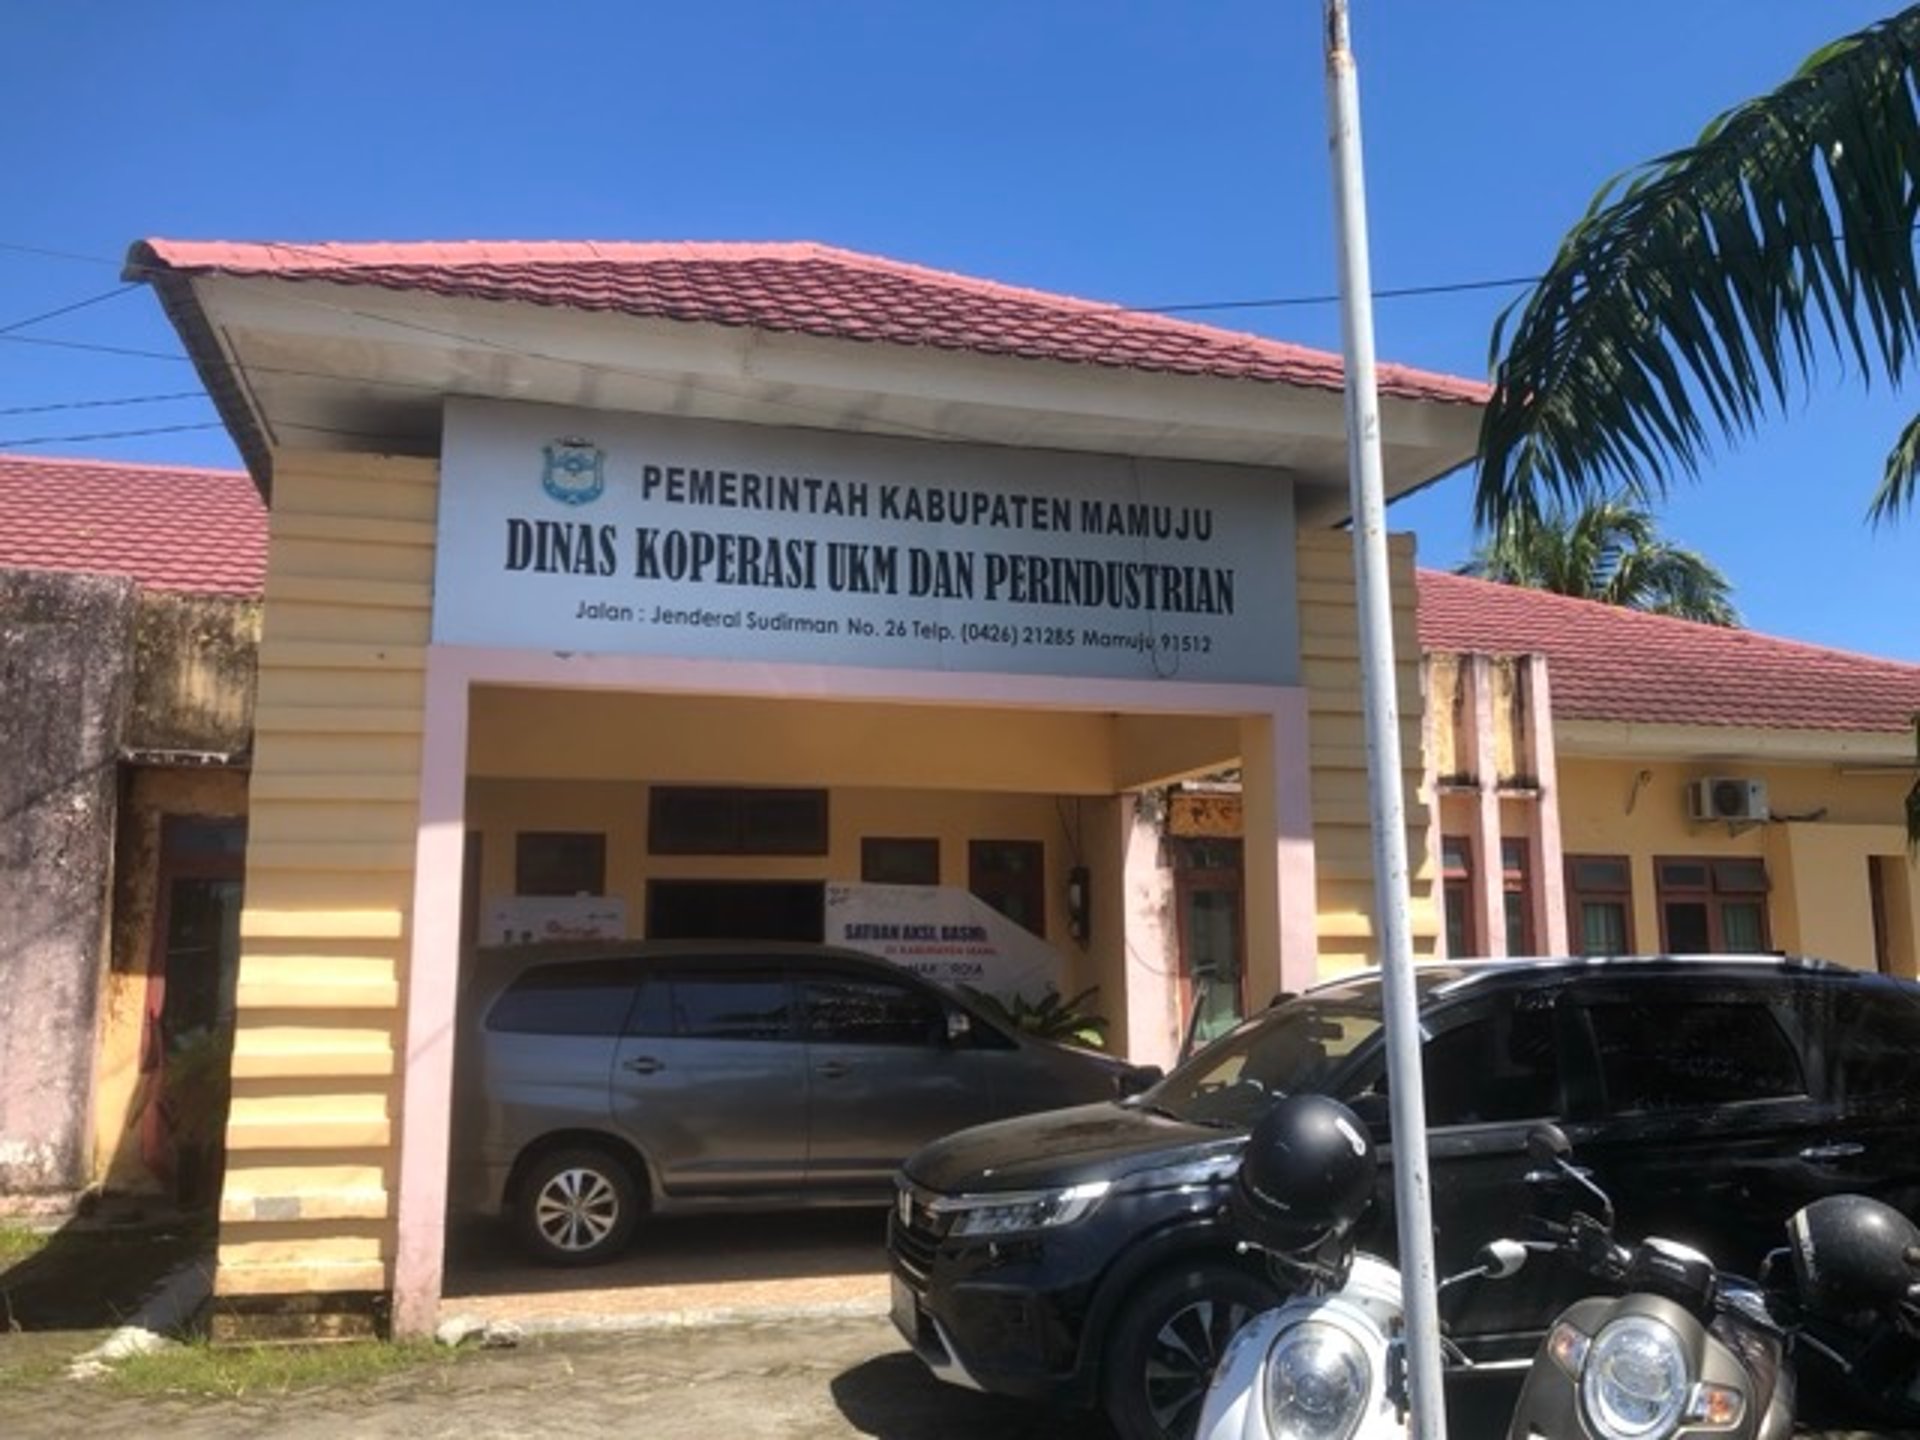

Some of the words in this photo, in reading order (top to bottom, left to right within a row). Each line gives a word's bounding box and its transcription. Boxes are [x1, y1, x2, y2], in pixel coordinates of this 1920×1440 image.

[642, 464, 867, 517] PEMERINTAH
[880, 485, 1072, 533] KABUPATEN
[1081, 500, 1213, 541] MAMUJU
[504, 517, 617, 577] DINAS
[634, 526, 818, 592] KOPERASI
[826, 541, 899, 595] UKM
[908, 547, 974, 599] DAN
[984, 552, 1235, 616] PERINDUSTRIAN
[576, 601, 633, 622] Jalan
[650, 605, 741, 629] Jenderal
[745, 611, 839, 634] Sudirman
[847, 617, 879, 636] No.
[885, 620, 906, 637] 26
[911, 621, 955, 641] Telp.
[960, 623, 1017, 645] (0426)
[1022, 627, 1074, 646] 21285
[1081, 631, 1152, 653] Mamuju
[1159, 636, 1212, 653] 91512
